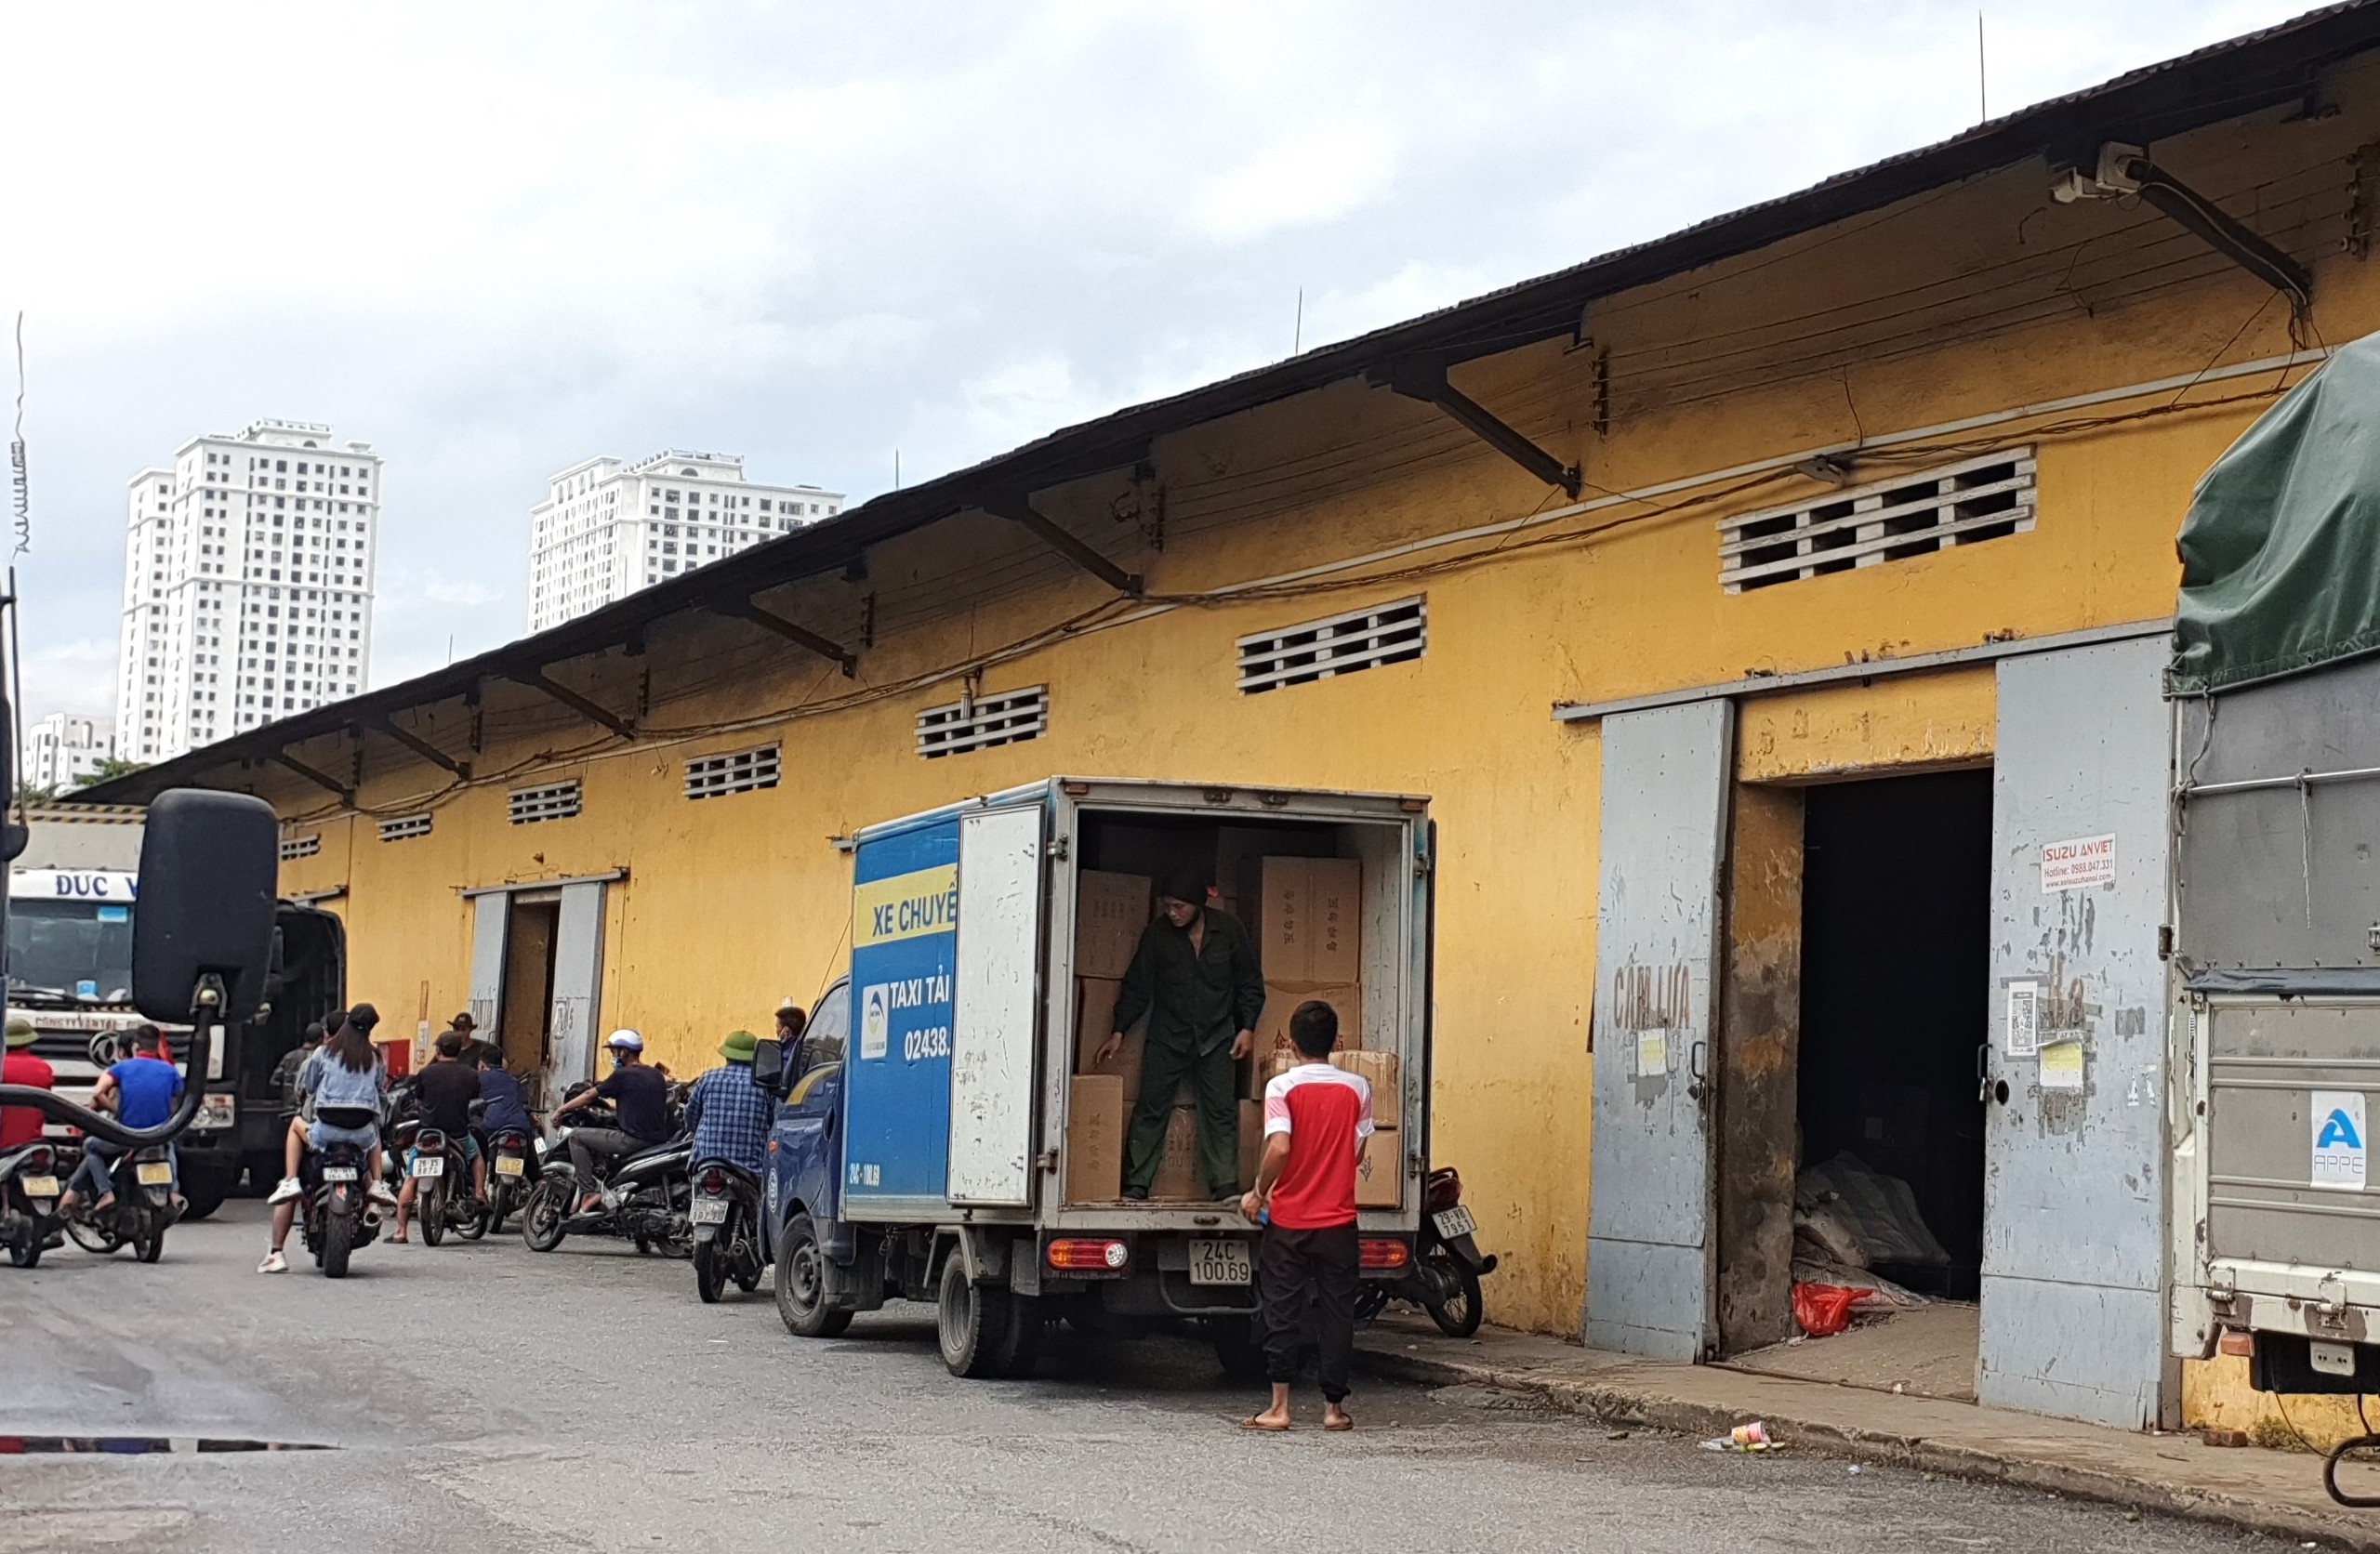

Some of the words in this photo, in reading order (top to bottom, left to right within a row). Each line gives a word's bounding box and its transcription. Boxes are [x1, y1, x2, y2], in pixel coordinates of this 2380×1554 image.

[2043, 844, 2077, 863] ISUZU
[2044, 865, 2069, 878] Hotline:
[872, 902, 894, 937] XE
[890, 977, 922, 1009] TAXI
[926, 964, 950, 1005] TẢI
[2314, 1154, 2364, 1174] APPE
[1203, 1241, 1236, 1260] 24C
[1194, 1261, 1250, 1282] 100.69
